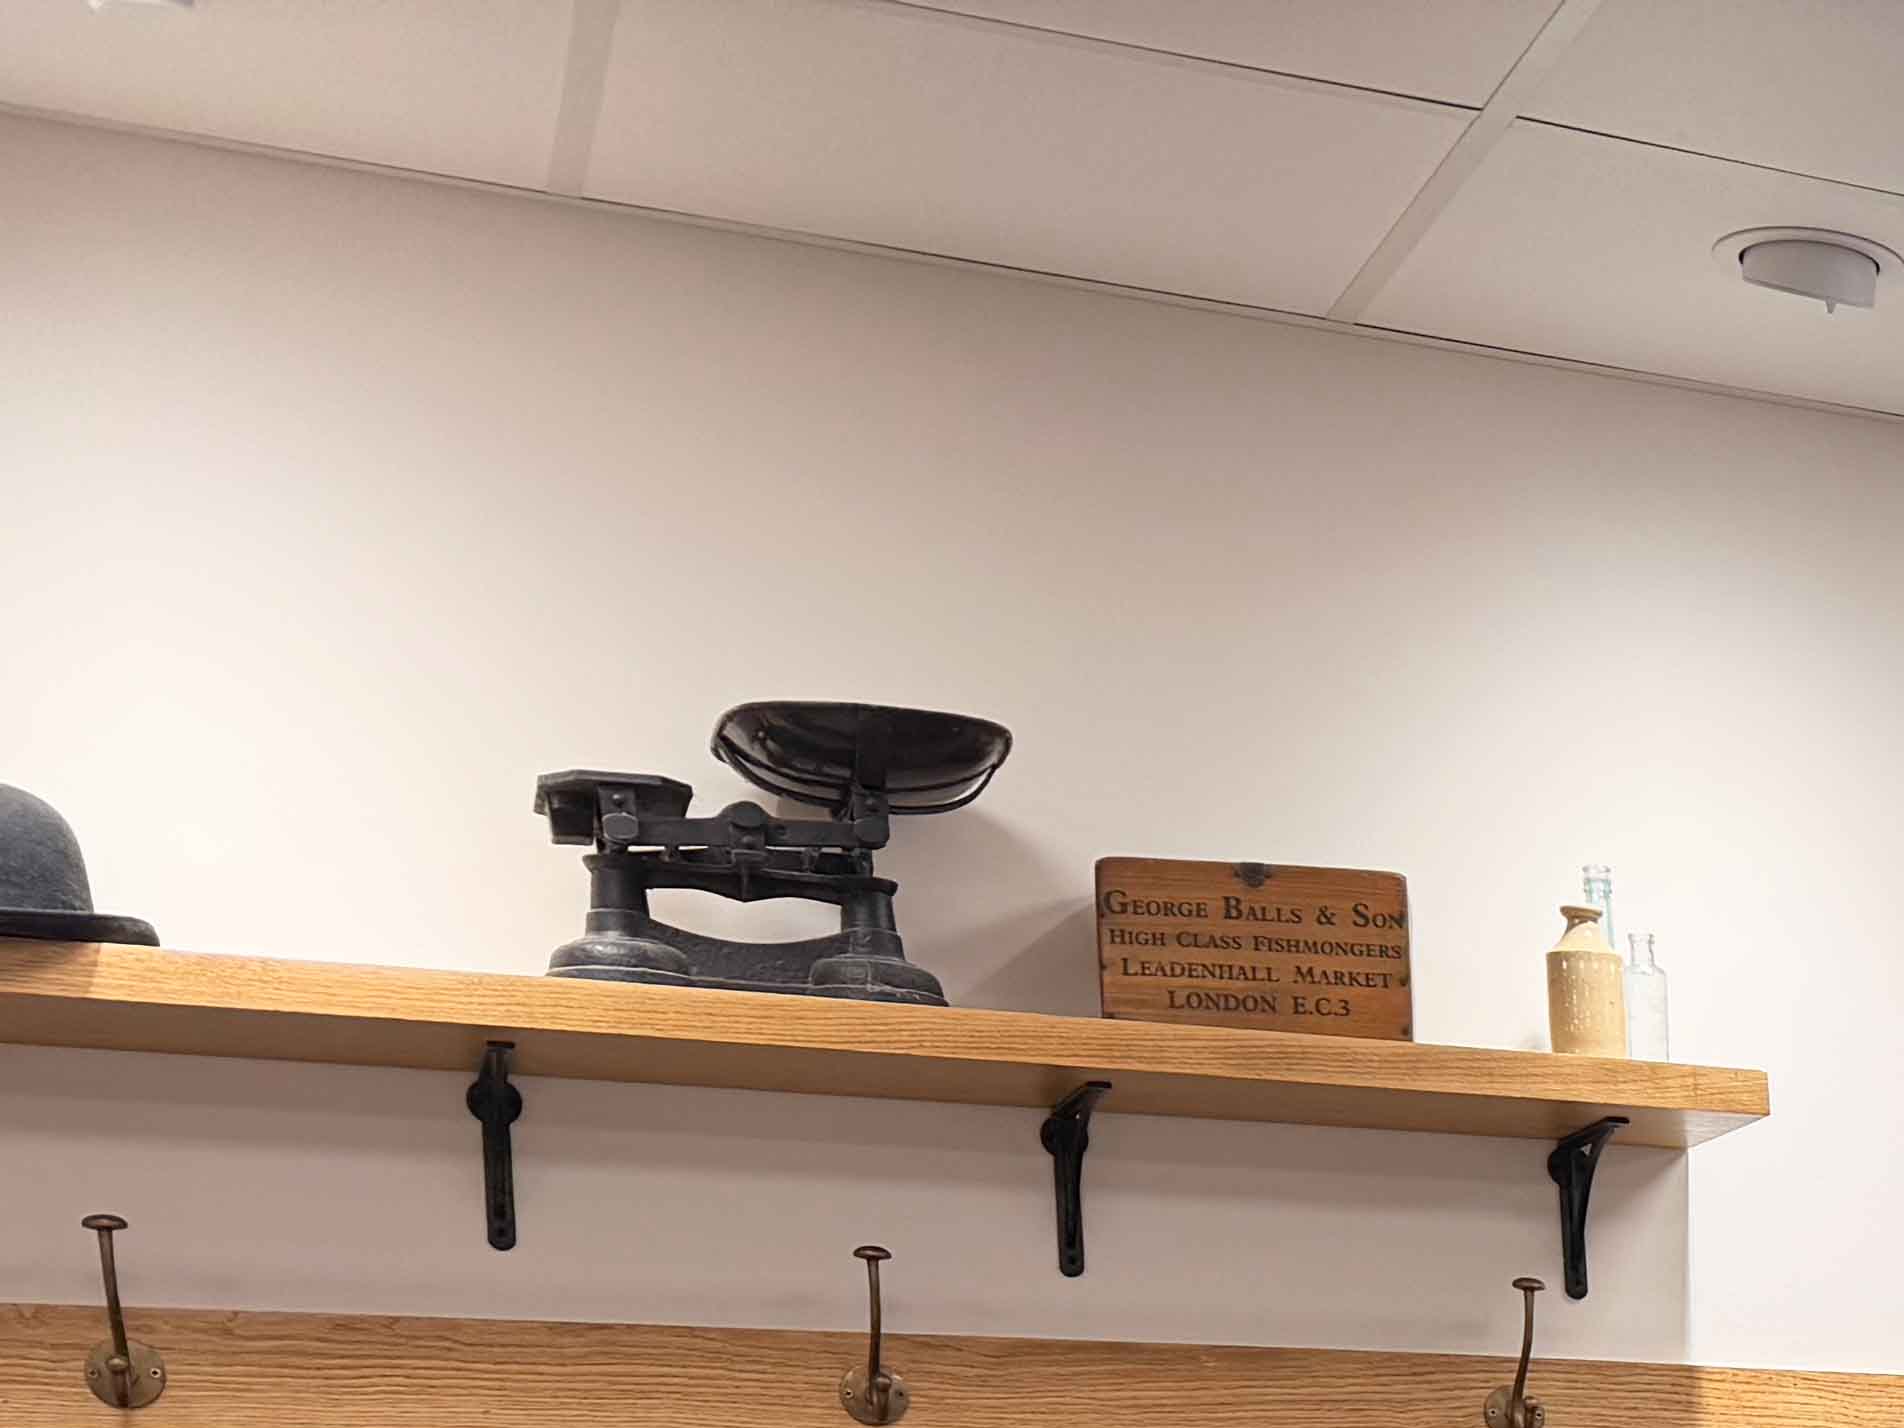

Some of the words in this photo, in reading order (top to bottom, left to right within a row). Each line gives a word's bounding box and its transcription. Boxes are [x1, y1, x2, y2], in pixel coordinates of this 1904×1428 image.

[1103, 889, 1208, 918] GEORGE
[1222, 895, 1304, 925] BALLS
[1315, 906, 1337, 927] &
[1351, 903, 1407, 930] SON
[1108, 928, 1167, 946] HIGH
[1175, 931, 1243, 951] CLASS
[1253, 935, 1403, 960] FISHMONGERS
[1121, 957, 1280, 983] LEADENHALL
[1293, 965, 1394, 989] MARKET
[1168, 990, 1278, 1014] LONDON
[1292, 996, 1352, 1018] E.C.3
